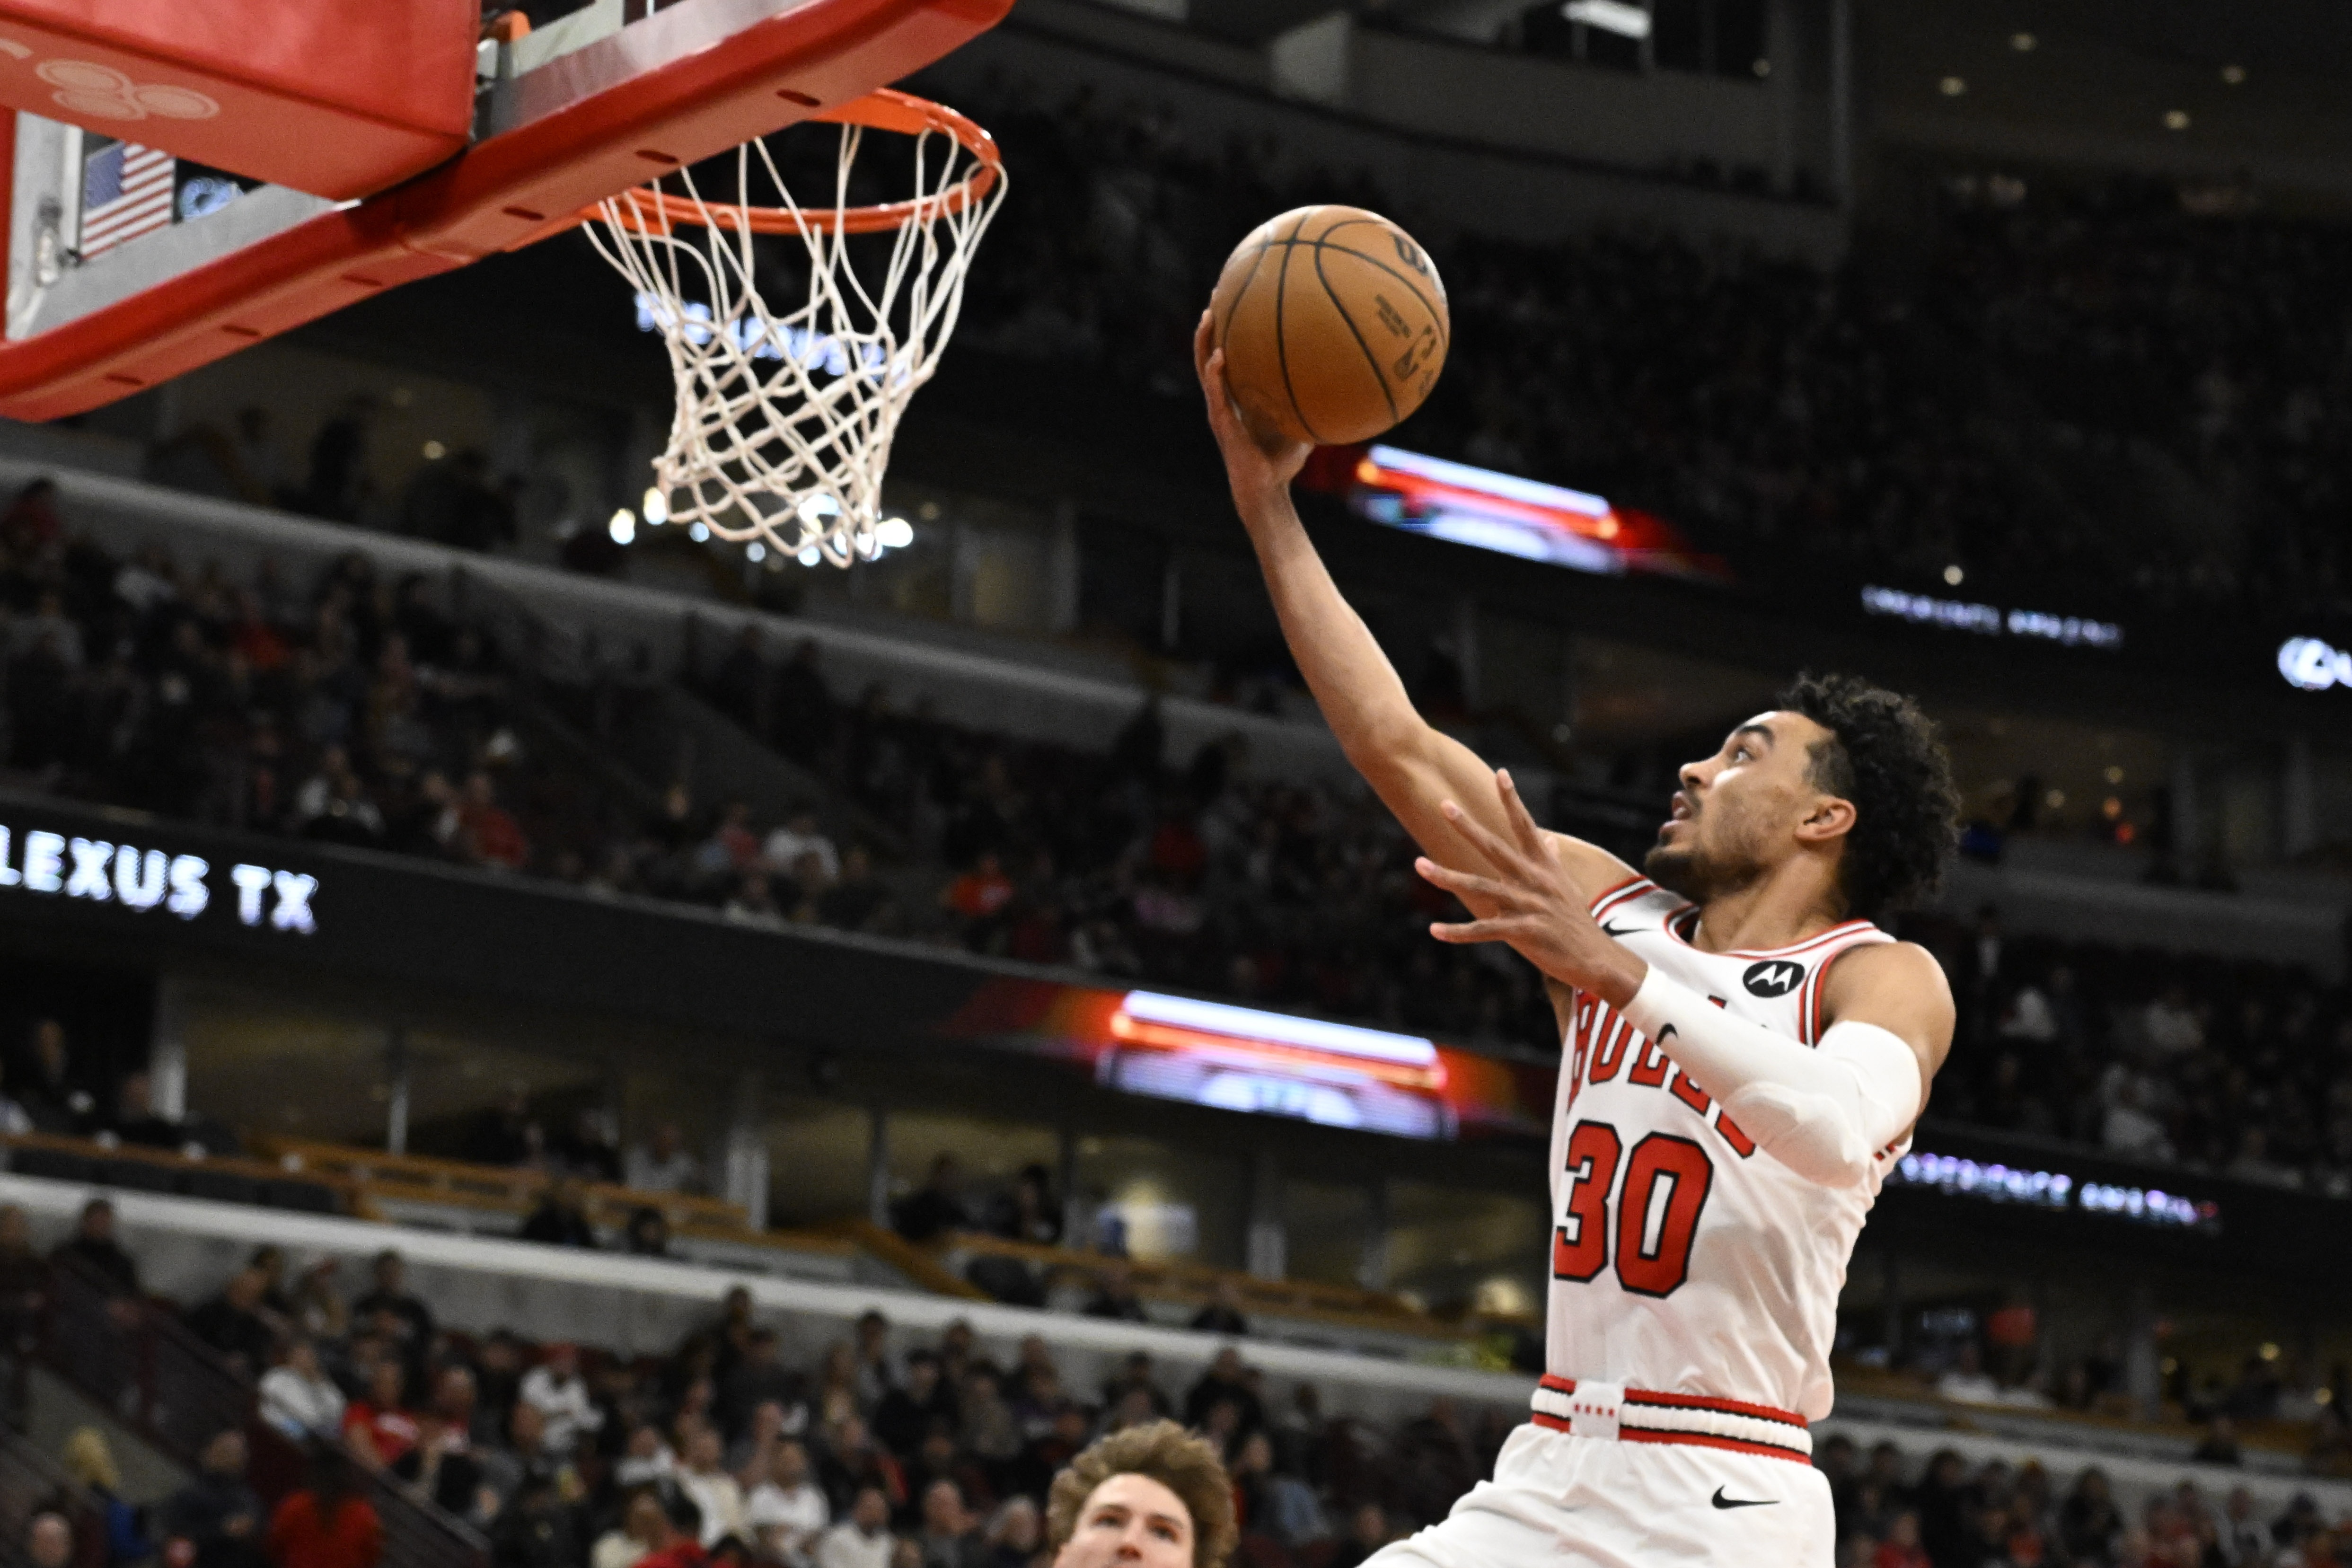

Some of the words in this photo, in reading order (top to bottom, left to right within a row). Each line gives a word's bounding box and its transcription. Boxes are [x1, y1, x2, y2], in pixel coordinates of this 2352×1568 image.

[0, 825, 210, 919] LEXUS
[231, 863, 319, 935] TX
[1567, 990, 1756, 1159] BUL
[1553, 1119, 1714, 1299] 30
